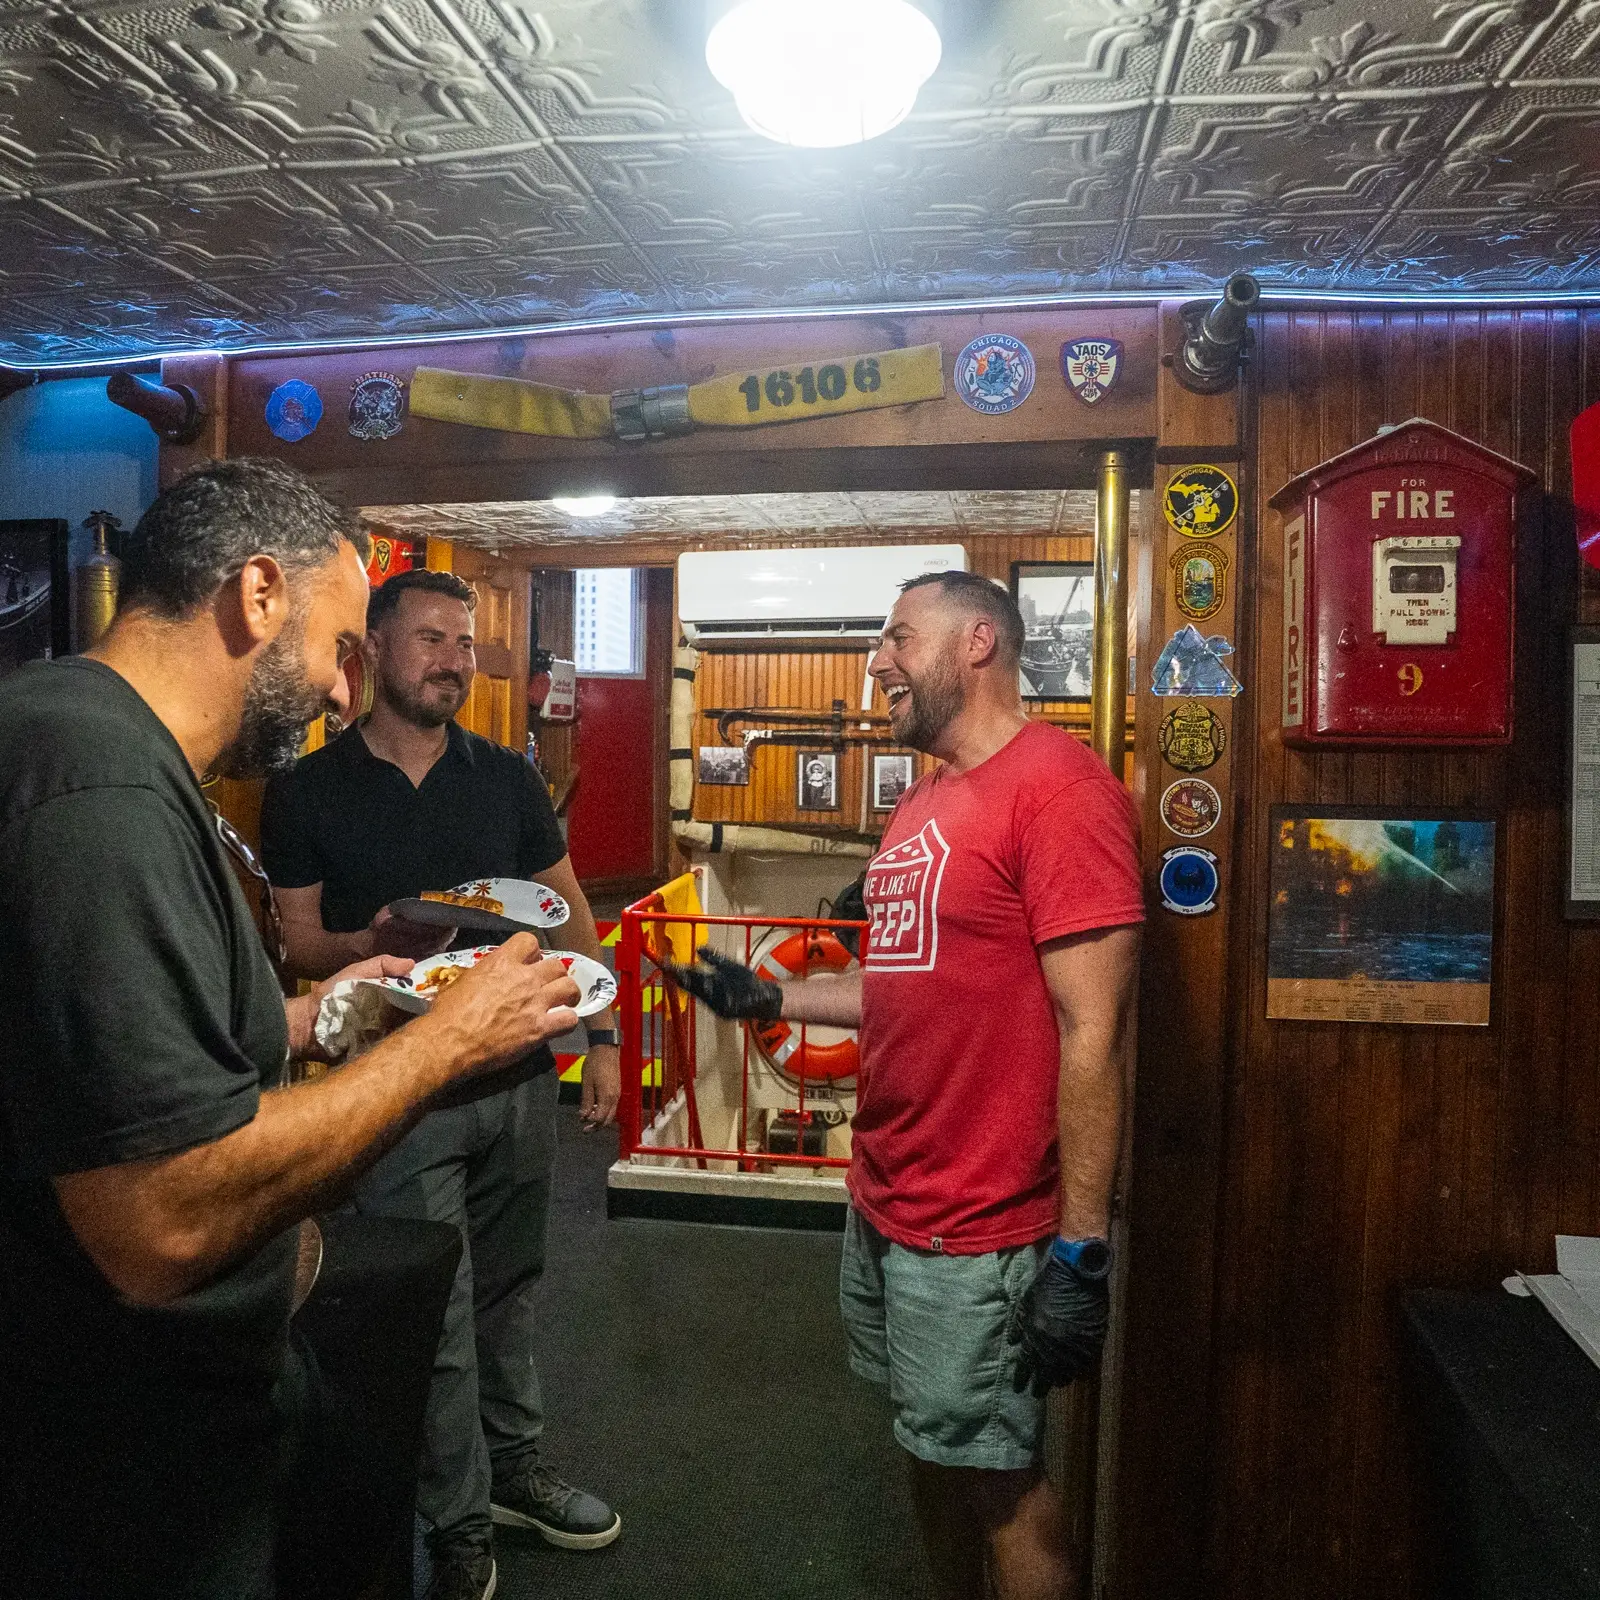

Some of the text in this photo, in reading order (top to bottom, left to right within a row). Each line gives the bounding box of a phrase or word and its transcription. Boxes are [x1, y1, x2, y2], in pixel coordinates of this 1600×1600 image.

[971, 336, 1019, 350] CHICAGO
[1076, 344, 1106, 356] TAOS
[349, 371, 405, 390] CHATHAM
[738, 357, 882, 413] 16106
[972, 400, 1008, 411] SQUAD
[1180, 467, 1214, 479] MICHIGAN
[1401, 478, 1427, 487] FOR
[1371, 490, 1455, 520] FIRE
[1287, 529, 1300, 715] FIRE
[1396, 663, 1424, 696] 9
[1193, 782, 1209, 791] PIZZA
[879, 872, 905, 896] LIKE
[907, 870, 921, 893] IT
